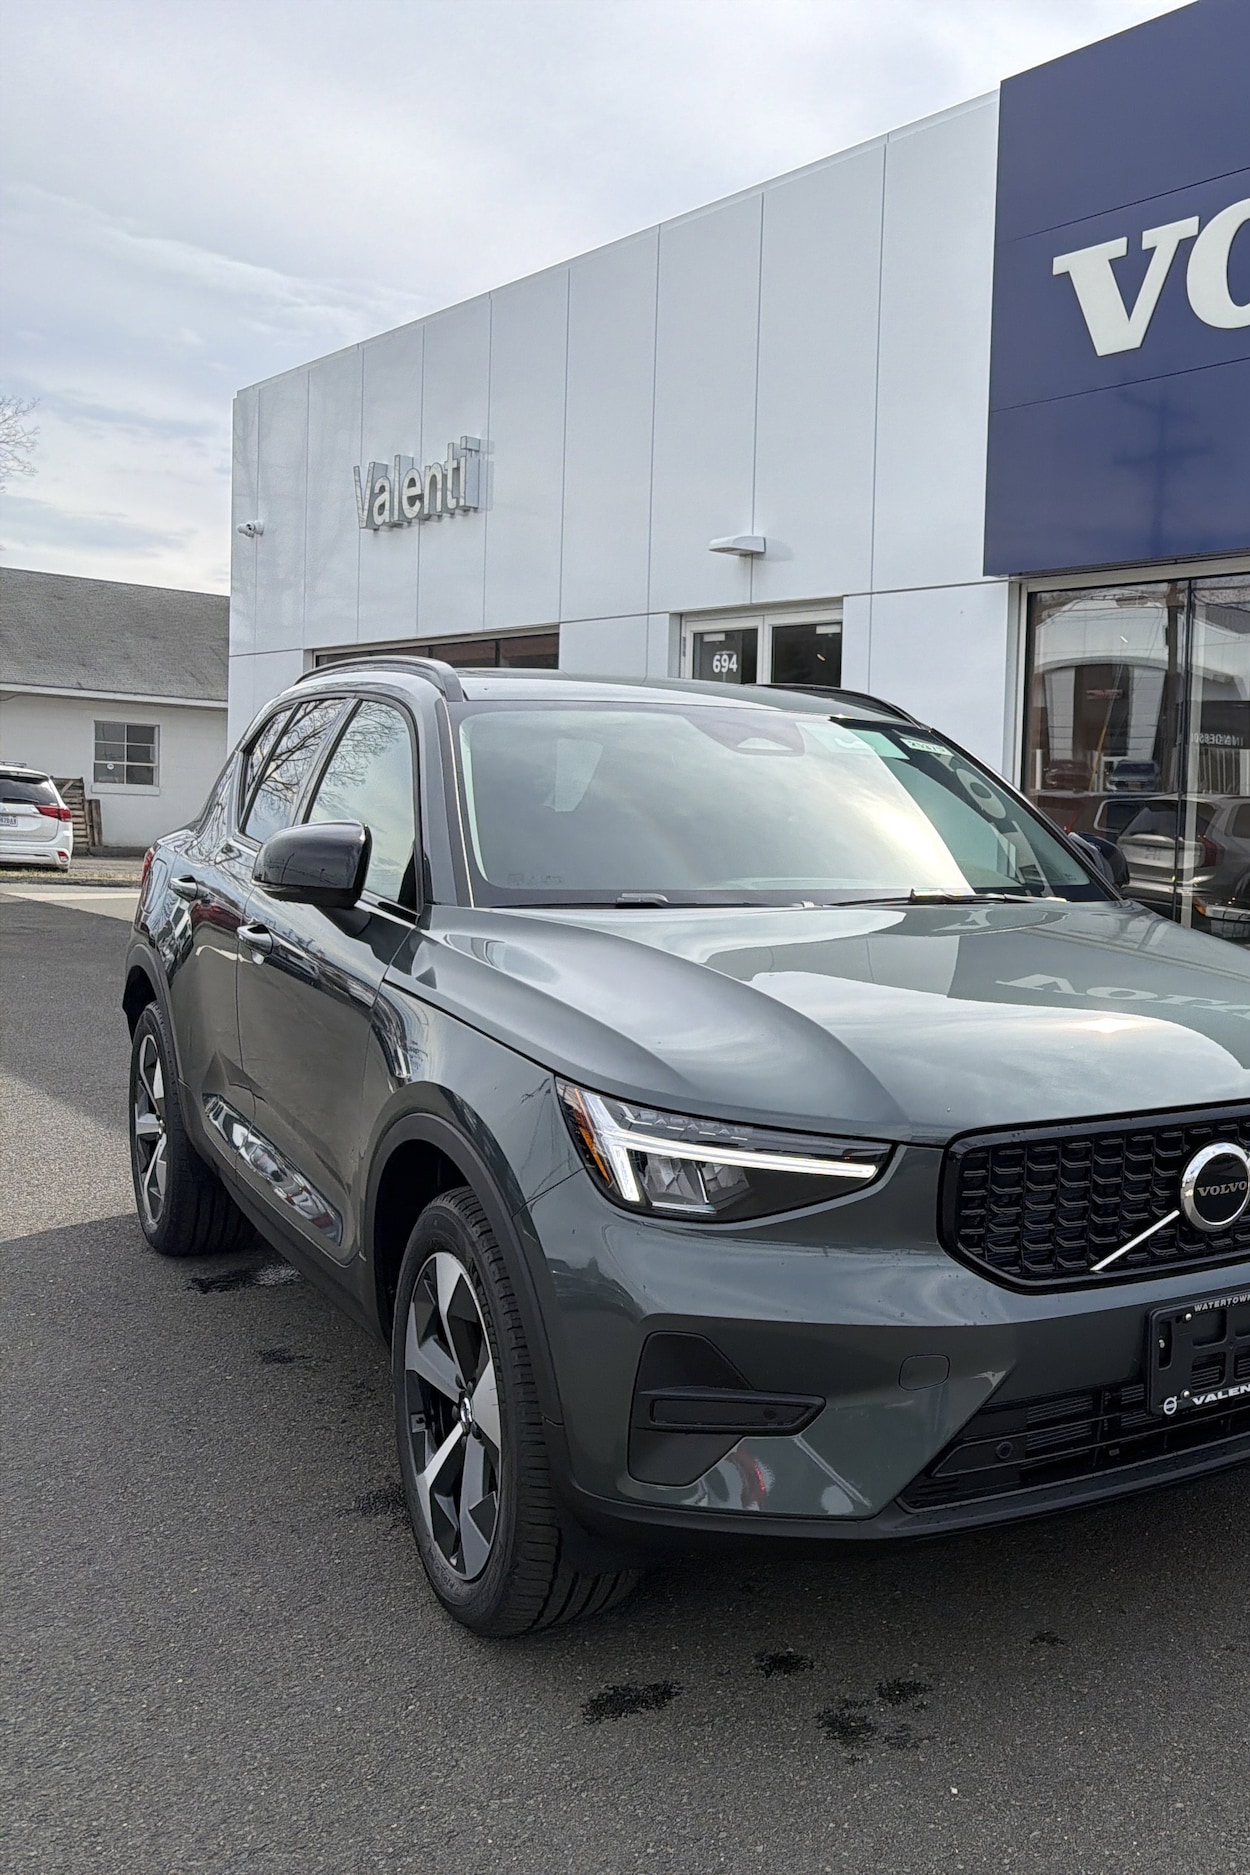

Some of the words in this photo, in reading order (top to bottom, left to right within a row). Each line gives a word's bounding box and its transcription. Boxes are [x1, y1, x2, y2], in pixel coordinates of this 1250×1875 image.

[353, 435, 472, 529] Valenti
[713, 654, 738, 673] 694
[1197, 1181, 1247, 1197] VOLVO
